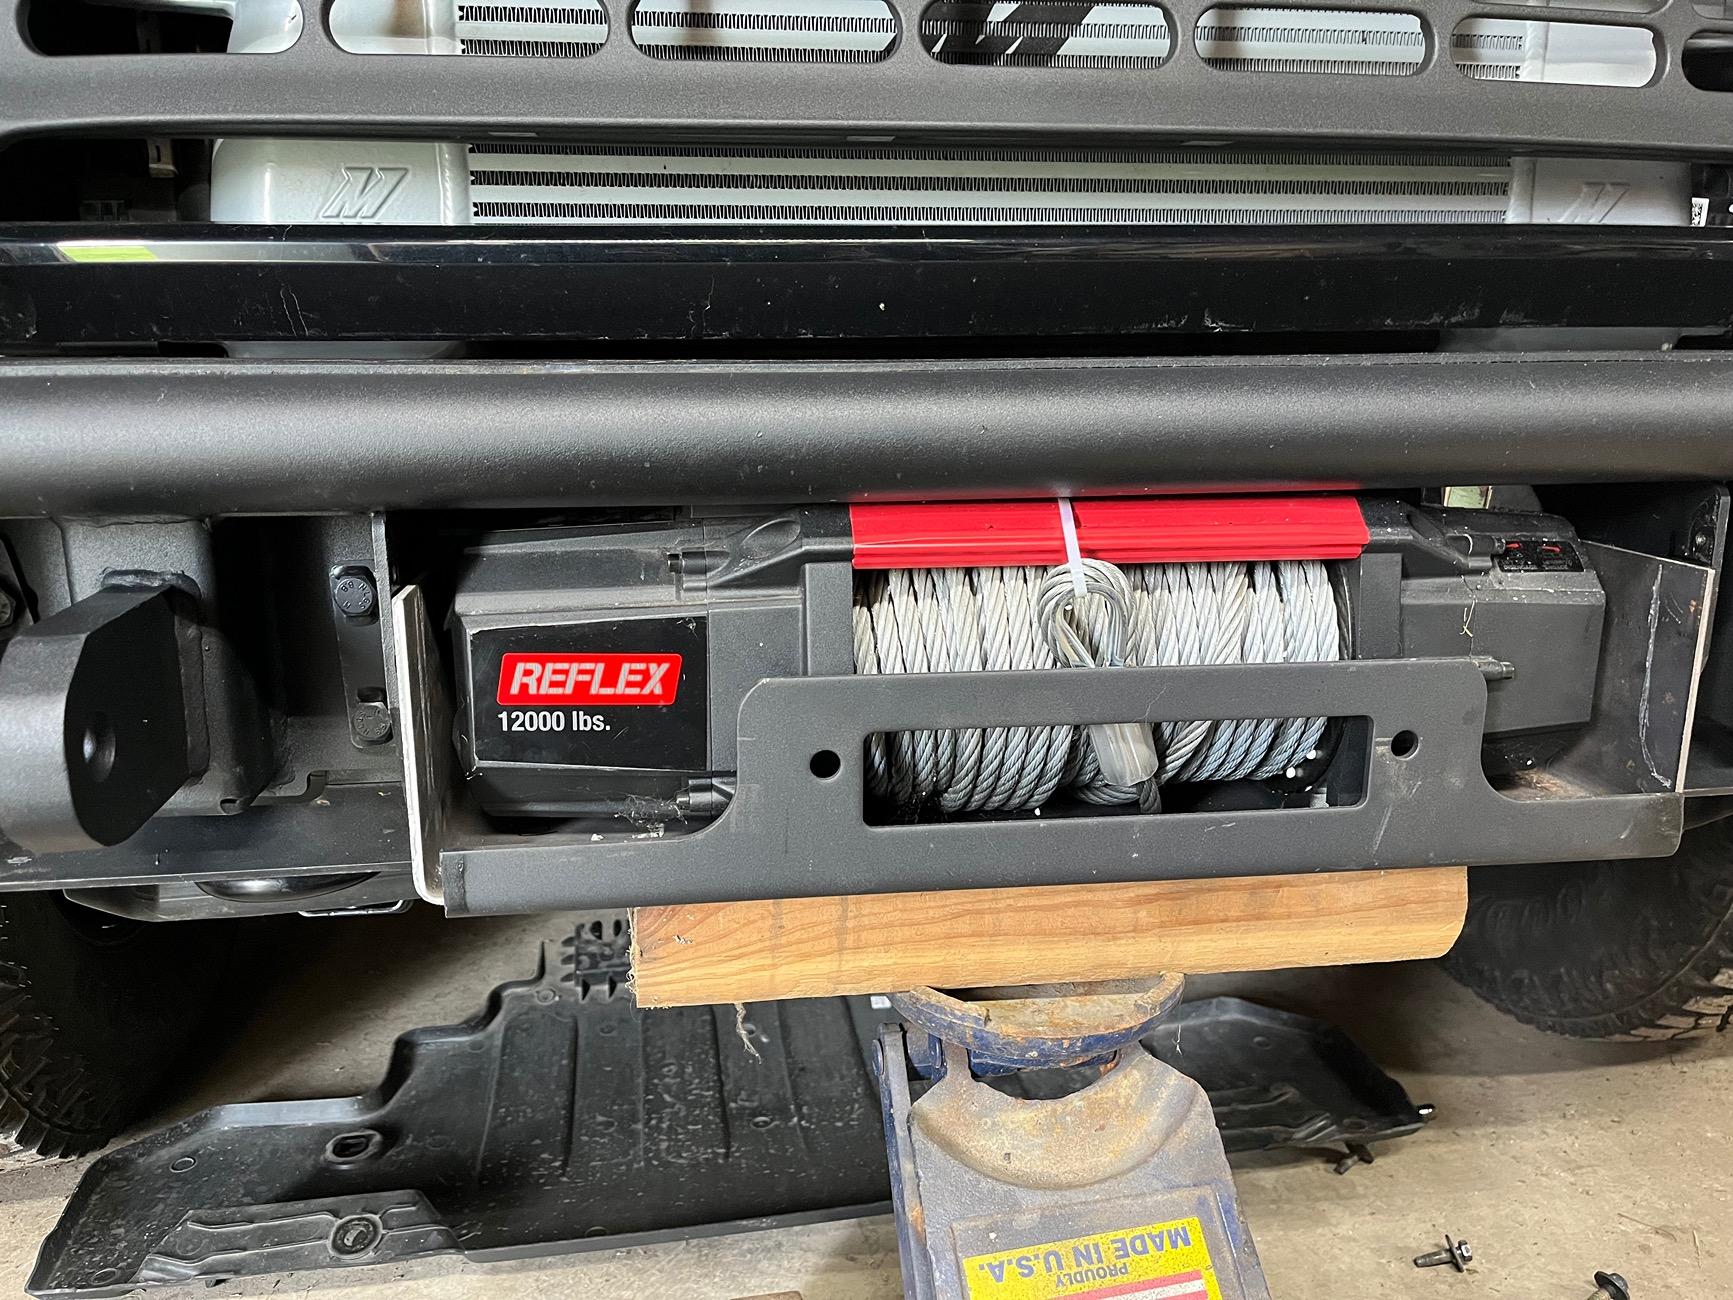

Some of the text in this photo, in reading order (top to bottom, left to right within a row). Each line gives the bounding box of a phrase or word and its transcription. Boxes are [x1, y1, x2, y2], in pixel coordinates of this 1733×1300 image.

[509, 662, 671, 695] REFLEX
[497, 710, 611, 732] 12000 lbs.
[978, 1226, 1192, 1283] MADE IN U.S.A.
[1056, 1262, 1129, 1288] PROUDLY
